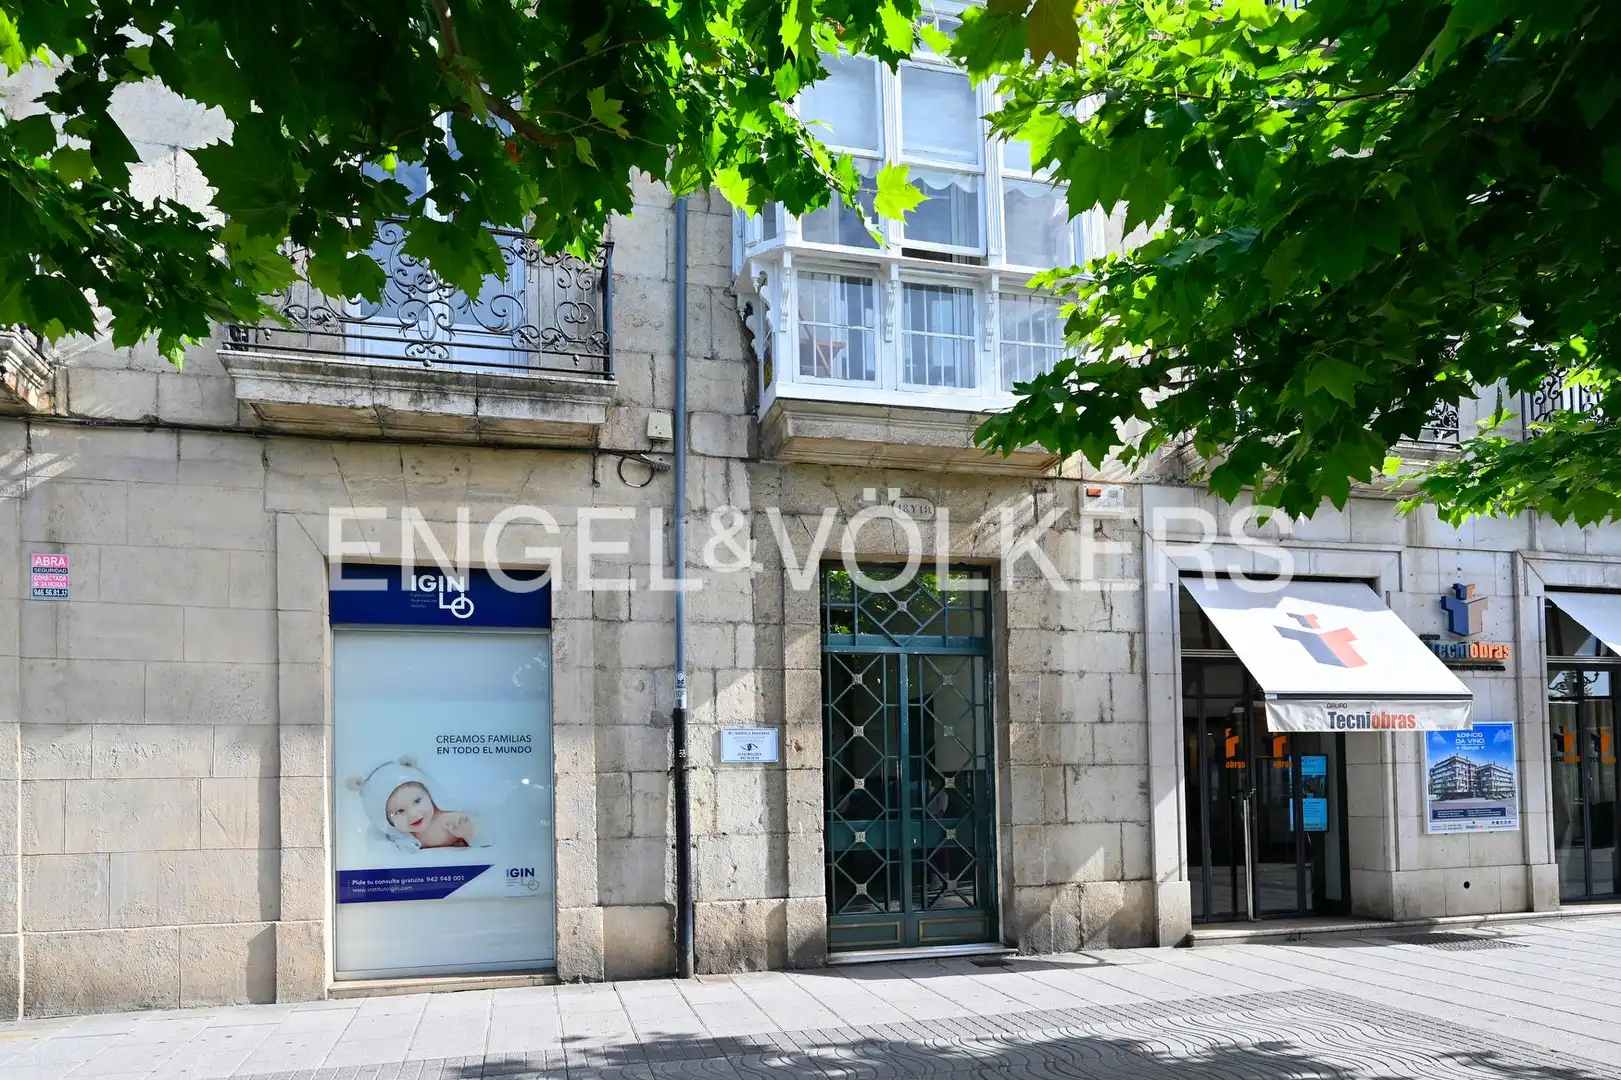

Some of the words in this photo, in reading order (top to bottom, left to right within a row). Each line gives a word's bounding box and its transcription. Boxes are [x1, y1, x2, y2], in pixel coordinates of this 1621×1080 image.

[35, 556, 66, 567] ABRA
[411, 574, 465, 593] IGIN
[1328, 711, 1416, 729] Tecniobras
[436, 734, 486, 744] CREAMOS
[488, 733, 532, 744] FAMILIAS
[436, 746, 450, 755] EN
[452, 746, 481, 755] TODO
[483, 746, 494, 754] EL
[495, 745, 532, 754] MUNDO
[506, 867, 535, 878] IGIN
[401, 877, 424, 885] gratuita
